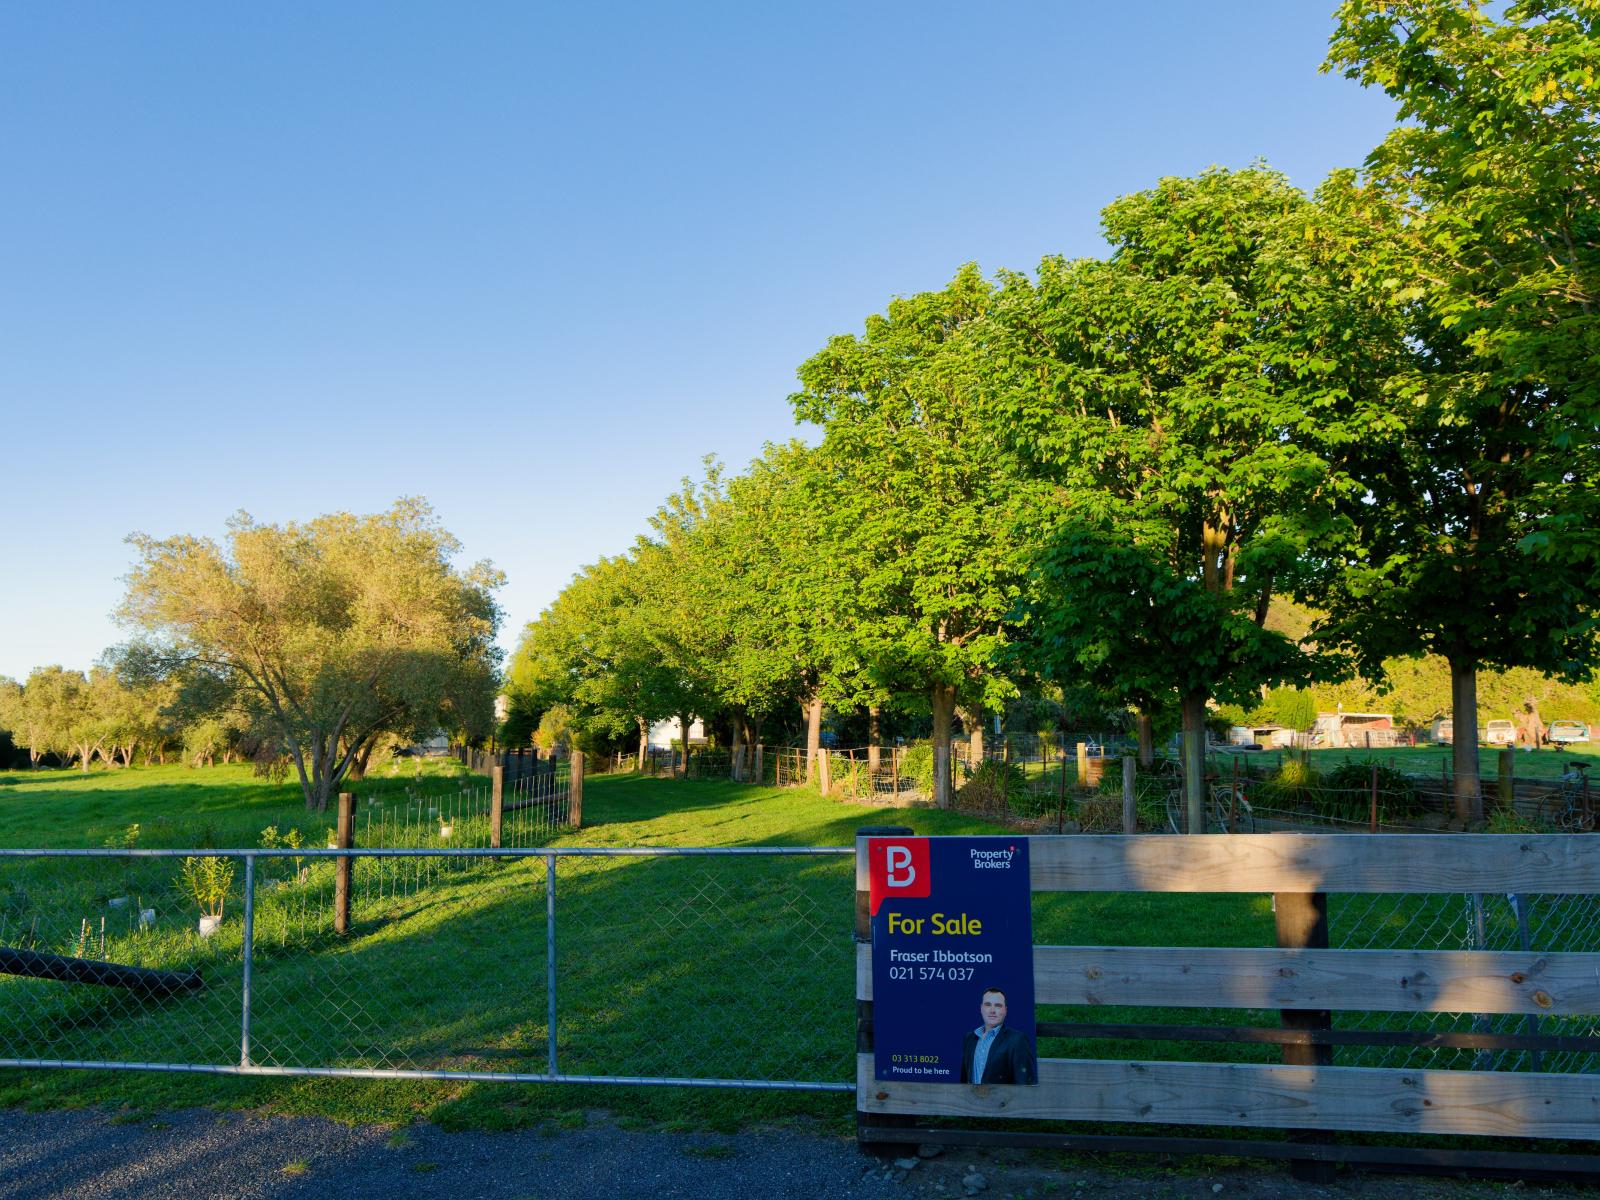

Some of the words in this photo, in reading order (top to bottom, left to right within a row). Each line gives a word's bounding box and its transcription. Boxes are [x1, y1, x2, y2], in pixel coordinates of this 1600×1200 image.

[970, 849, 1013, 860] Property
[974, 859, 1011, 869] Brokers
[888, 912, 925, 935] For
[931, 912, 982, 935] Sale
[890, 950, 929, 962] Fraser
[933, 950, 993, 963] Ibbotson
[889, 967, 914, 980] 021
[919, 967, 945, 980] 574
[948, 967, 975, 981] 037
[892, 1054, 902, 1063] 03
[904, 1055, 918, 1063] 313
[919, 1055, 939, 1064] 8022
[892, 1066, 913, 1074] Proud
[914, 1067, 922, 1075] to
[923, 1066, 933, 1075] be
[933, 1067, 950, 1075] here
